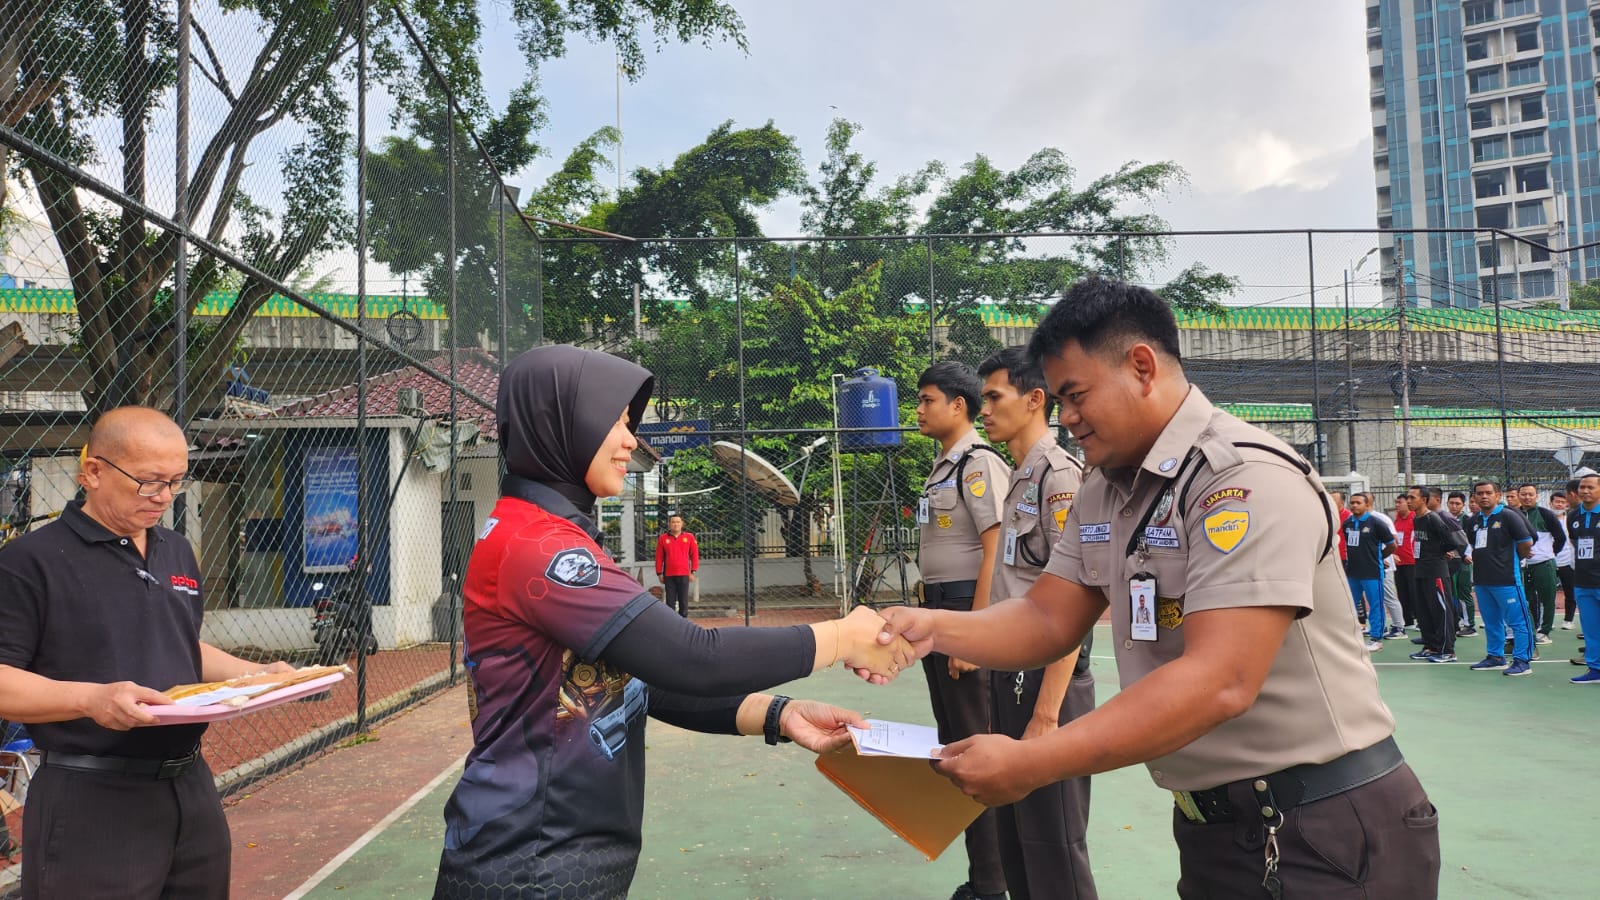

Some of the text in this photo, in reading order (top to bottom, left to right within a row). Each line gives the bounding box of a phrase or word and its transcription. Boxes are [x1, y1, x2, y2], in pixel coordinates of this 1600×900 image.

[1206, 489, 1243, 507] JAKARTA
[1146, 527, 1172, 537] SATPAM
[1208, 524, 1239, 534] mandiri
[1578, 546, 1592, 558] 07
